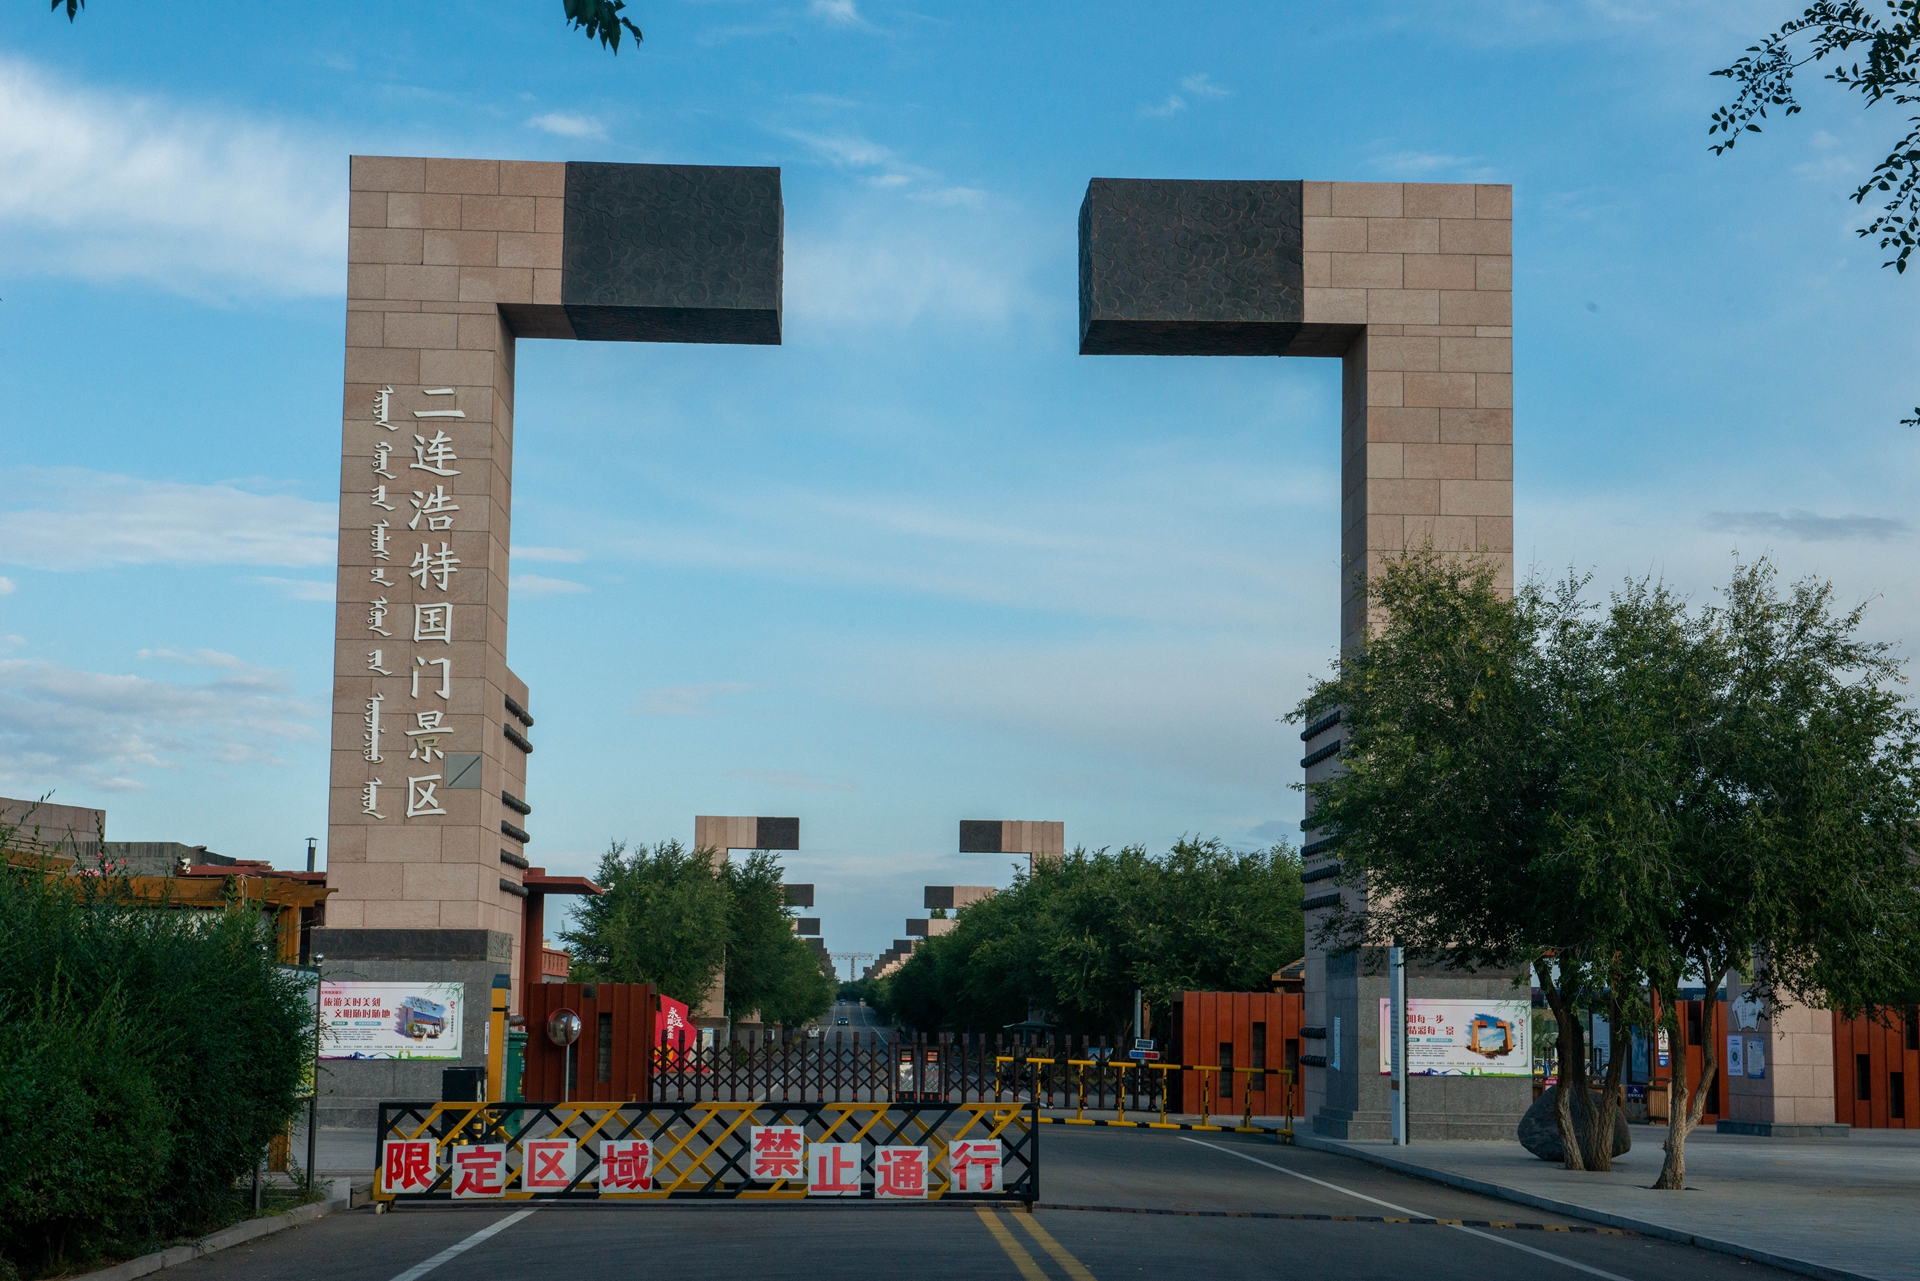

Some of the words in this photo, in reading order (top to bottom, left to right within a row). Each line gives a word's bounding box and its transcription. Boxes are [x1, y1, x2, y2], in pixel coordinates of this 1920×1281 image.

[404, 388, 466, 818] 二连浩特国门景区
[1407, 1014, 1444, 1024] 明每一步
[385, 1141, 651, 1196] 限定区域
[753, 1128, 1000, 1196] 禁止通行
